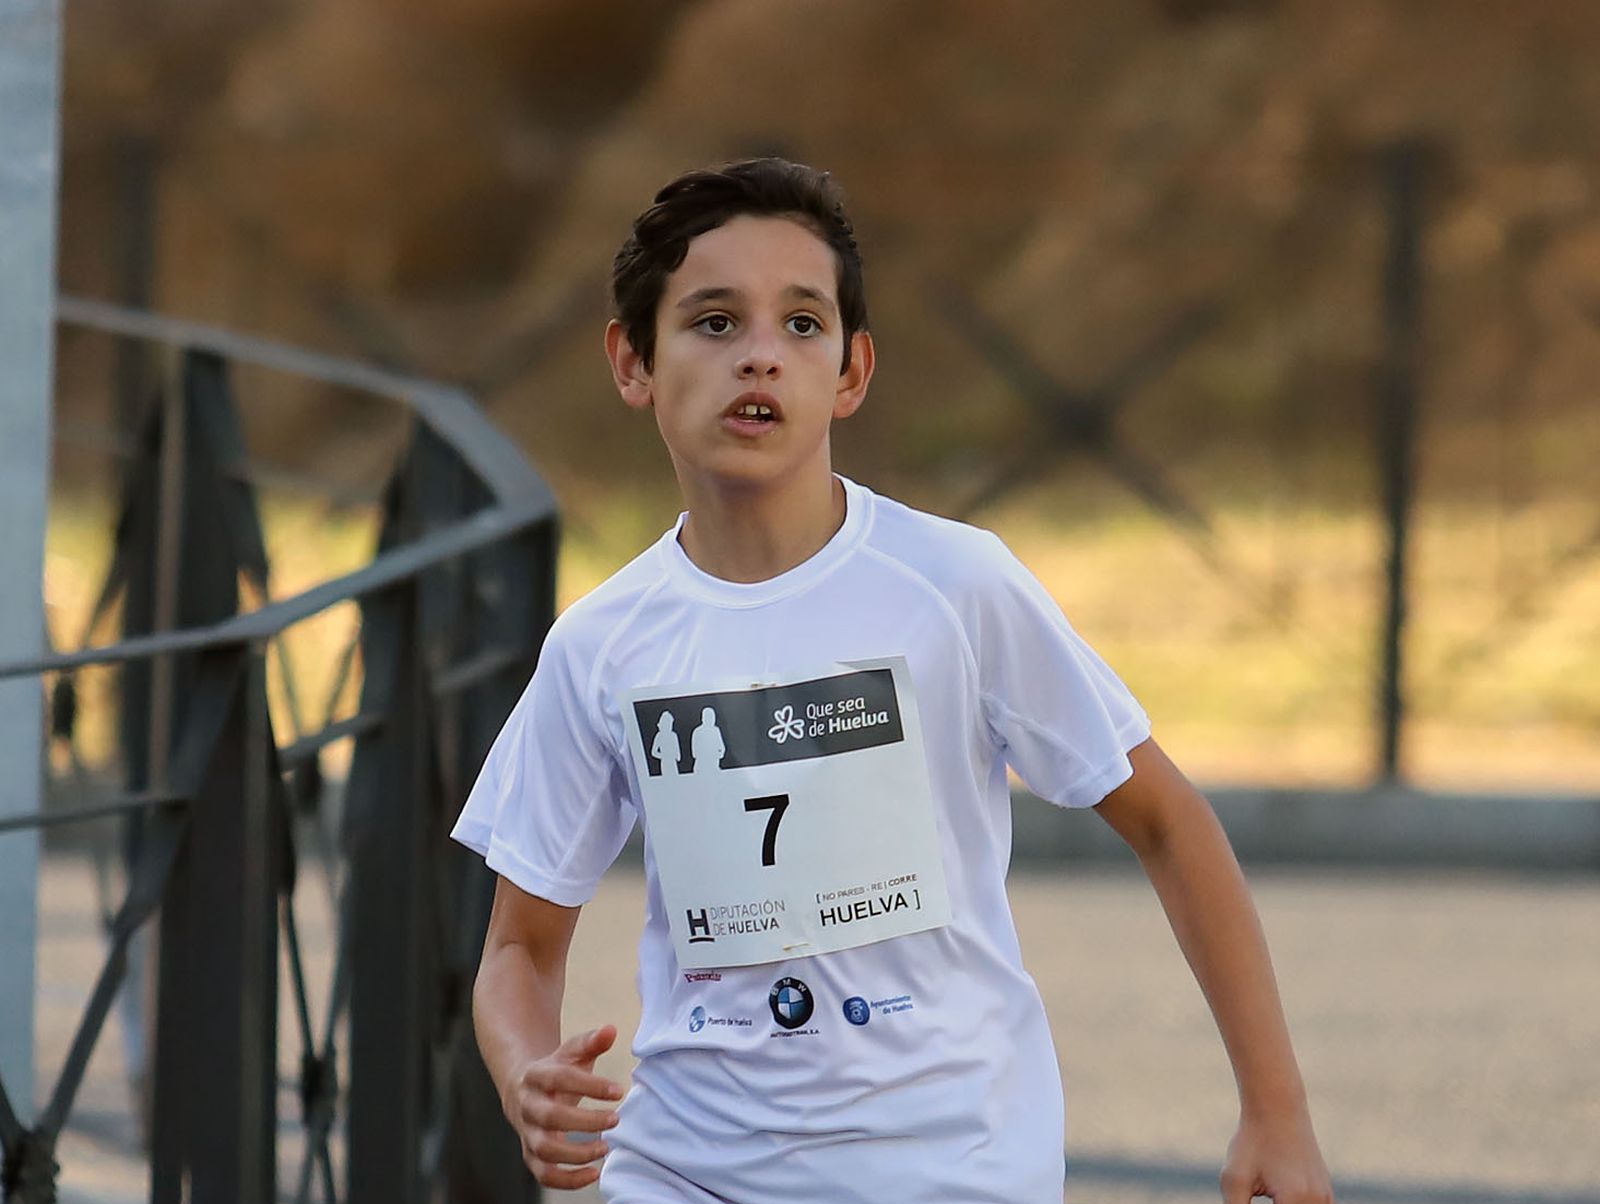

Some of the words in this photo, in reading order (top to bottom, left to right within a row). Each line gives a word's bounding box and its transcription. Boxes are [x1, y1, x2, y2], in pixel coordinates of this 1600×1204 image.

[806, 703, 834, 720] Que
[837, 697, 866, 714] sea
[808, 721, 825, 737] de
[828, 711, 889, 734] Huelva
[743, 793, 790, 866] 7
[822, 892, 836, 901] NO
[838, 886, 865, 898] PARES
[710, 899, 786, 920] DIPUTACIÓN
[820, 892, 909, 927] HUELVA
[713, 922, 727, 936] DE
[728, 917, 780, 934] HUELVA
